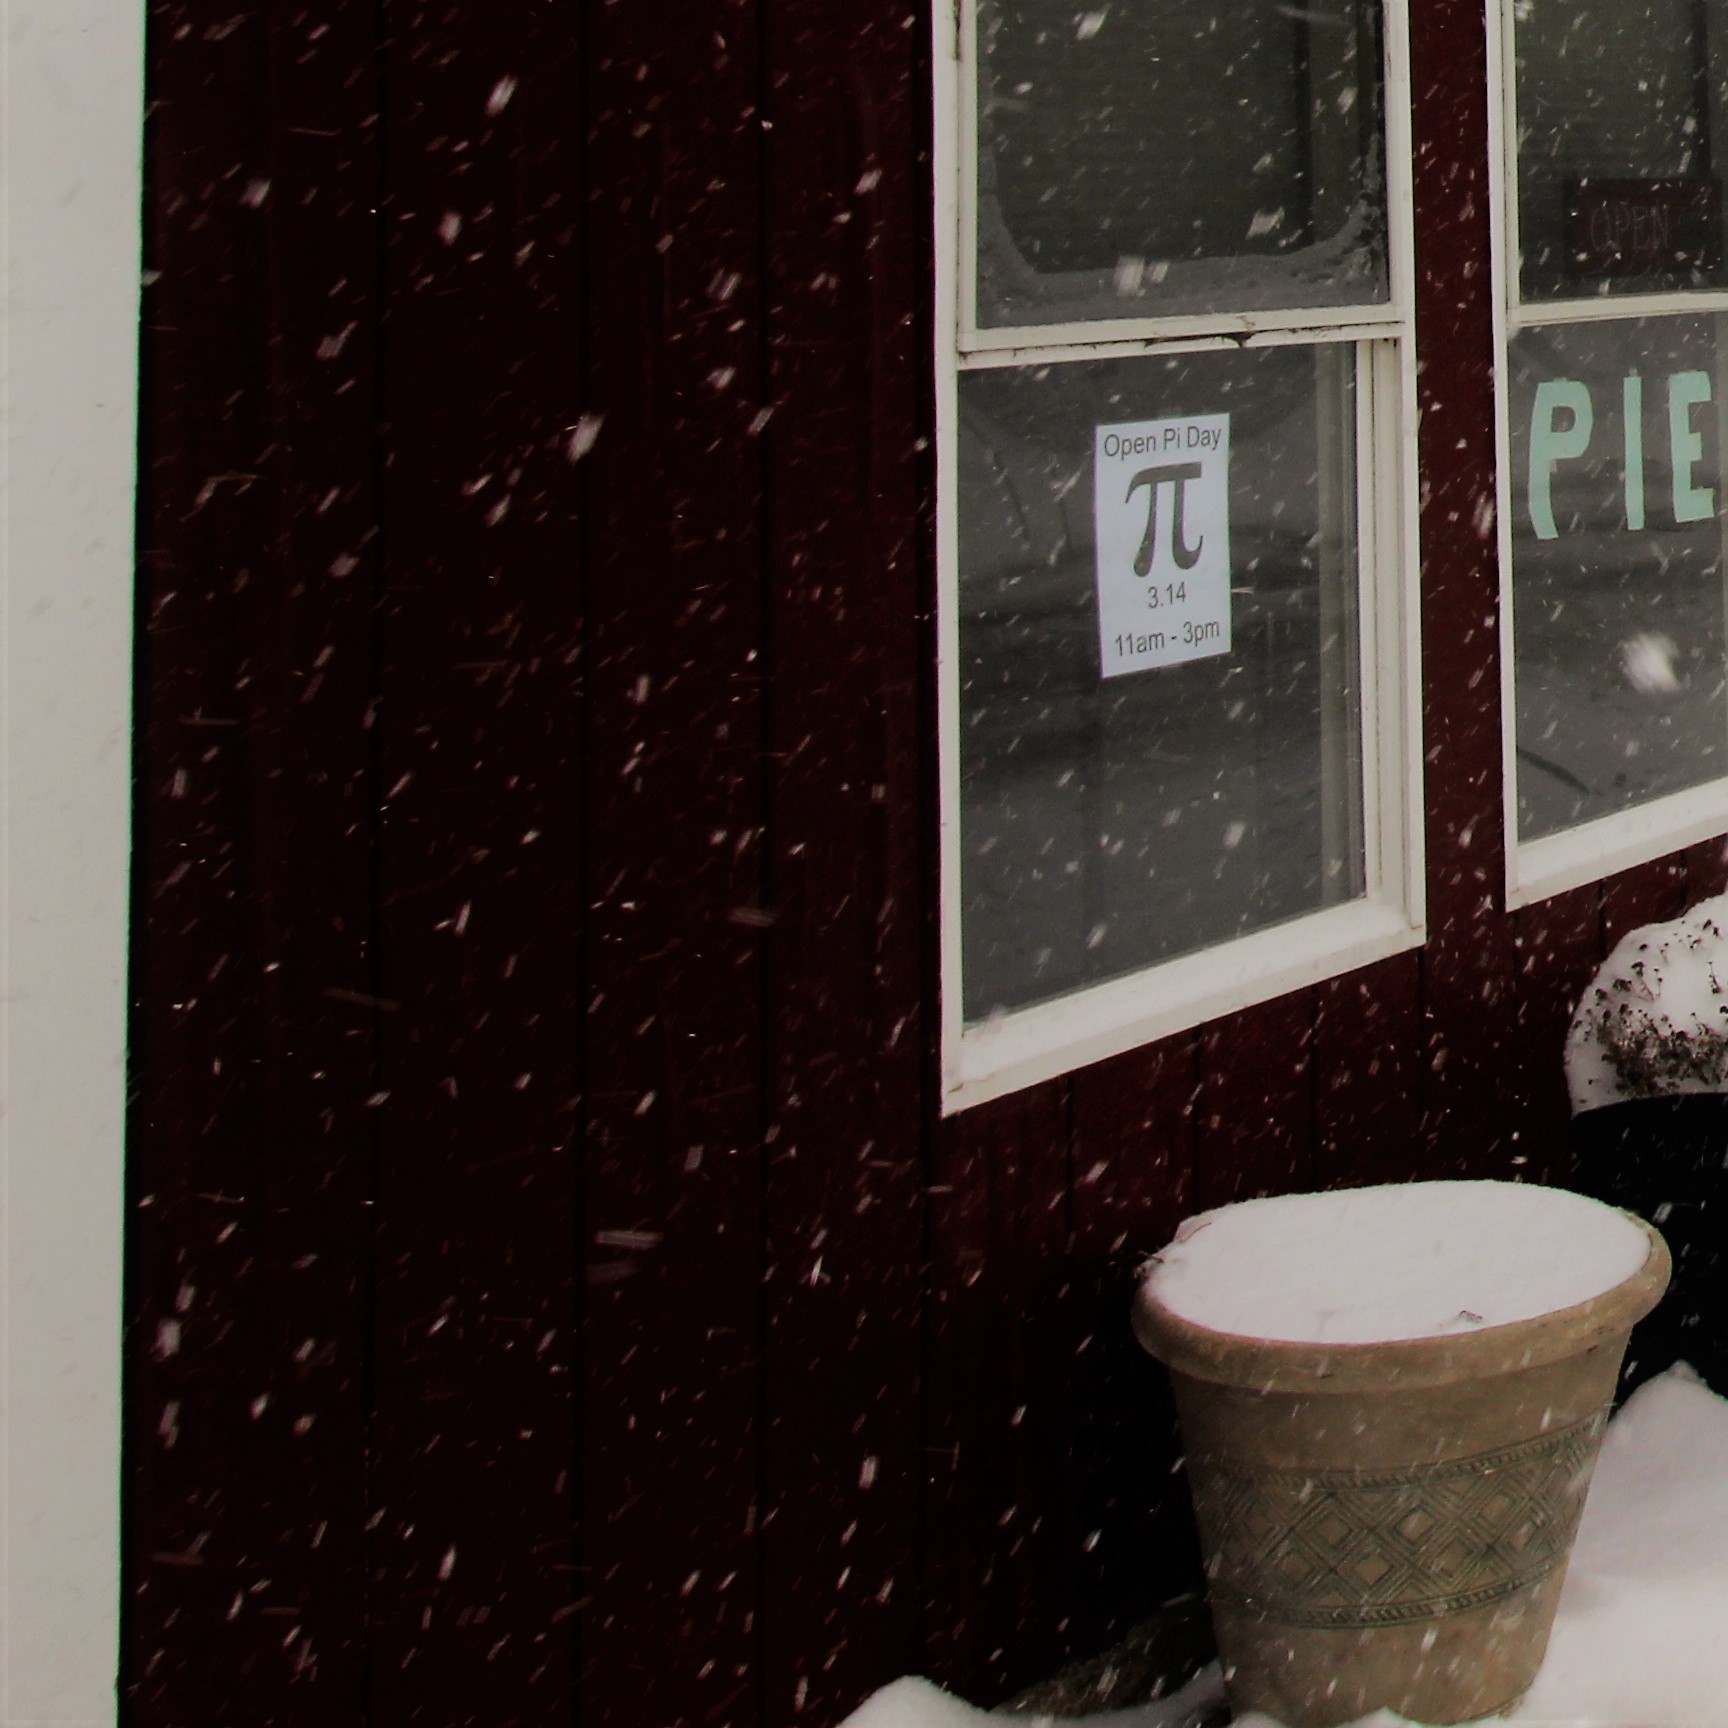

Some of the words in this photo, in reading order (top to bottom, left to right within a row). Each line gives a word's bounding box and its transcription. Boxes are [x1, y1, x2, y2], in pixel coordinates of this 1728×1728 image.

[1104, 432, 1156, 460] Open
[1163, 427, 1182, 451] Pi
[1187, 425, 1222, 451] Day
[1528, 370, 1715, 539] PIE
[1125, 461, 1203, 578] π
[1148, 581, 1187, 609] 3.14
[1115, 629, 1165, 657] 11am
[1183, 620, 1220, 646] 3pm
